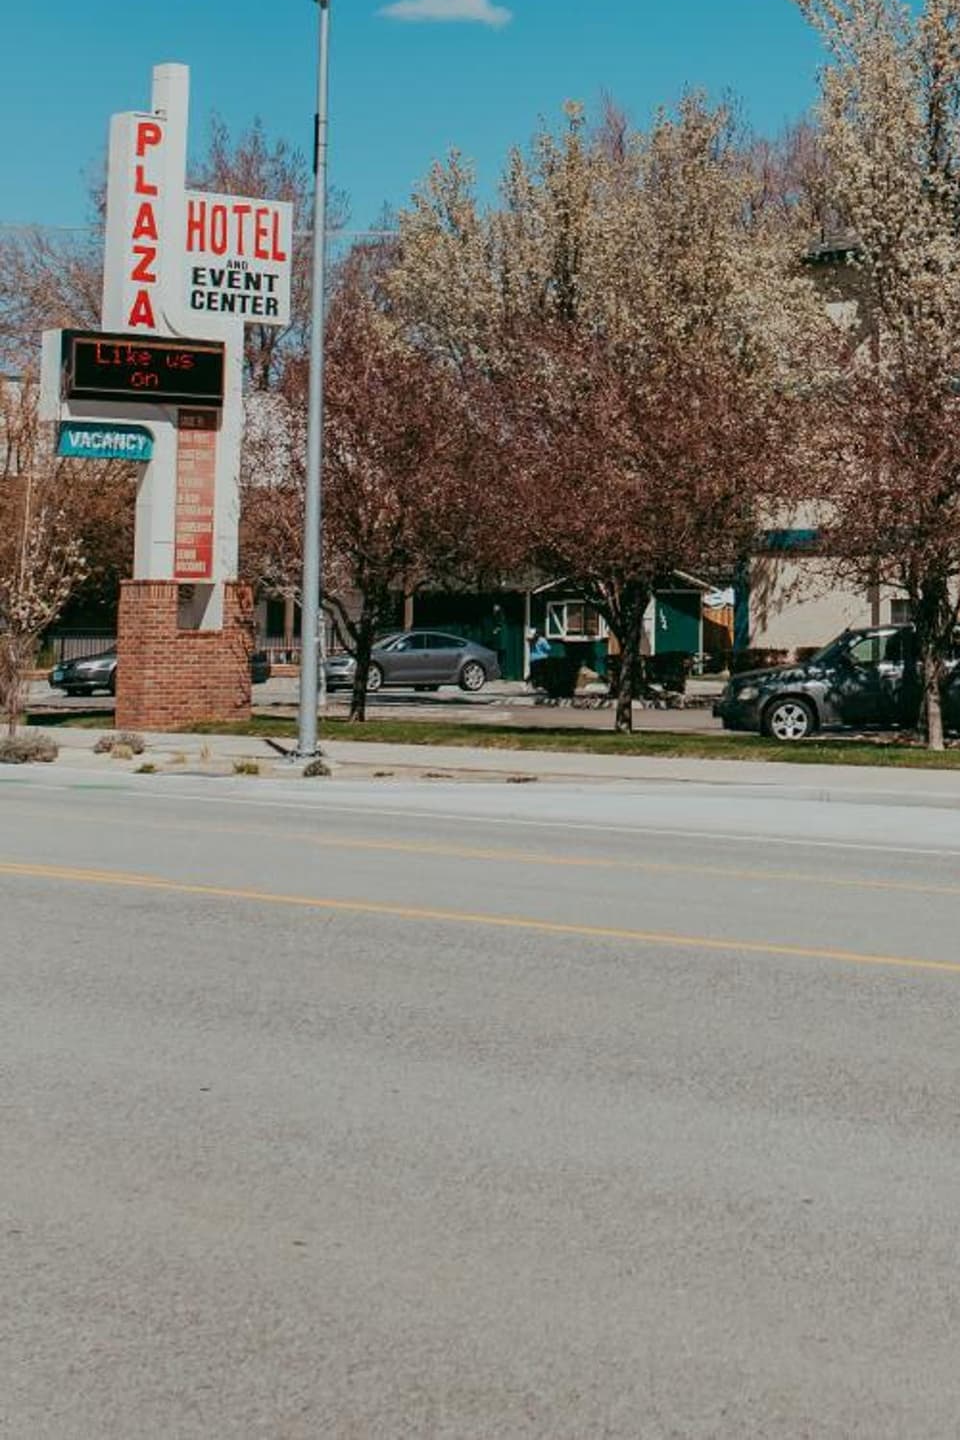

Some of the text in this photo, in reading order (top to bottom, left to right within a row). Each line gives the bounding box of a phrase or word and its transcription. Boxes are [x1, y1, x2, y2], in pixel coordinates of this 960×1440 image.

[128, 122, 162, 329] PLAZA
[186, 200, 286, 262] HOTEL
[226, 260, 249, 271] AND
[191, 266, 279, 292] EVENT
[190, 289, 278, 316] CENTER
[166, 353, 195, 369] us
[131, 371, 159, 387] on
[68, 430, 147, 451] VACANCY
